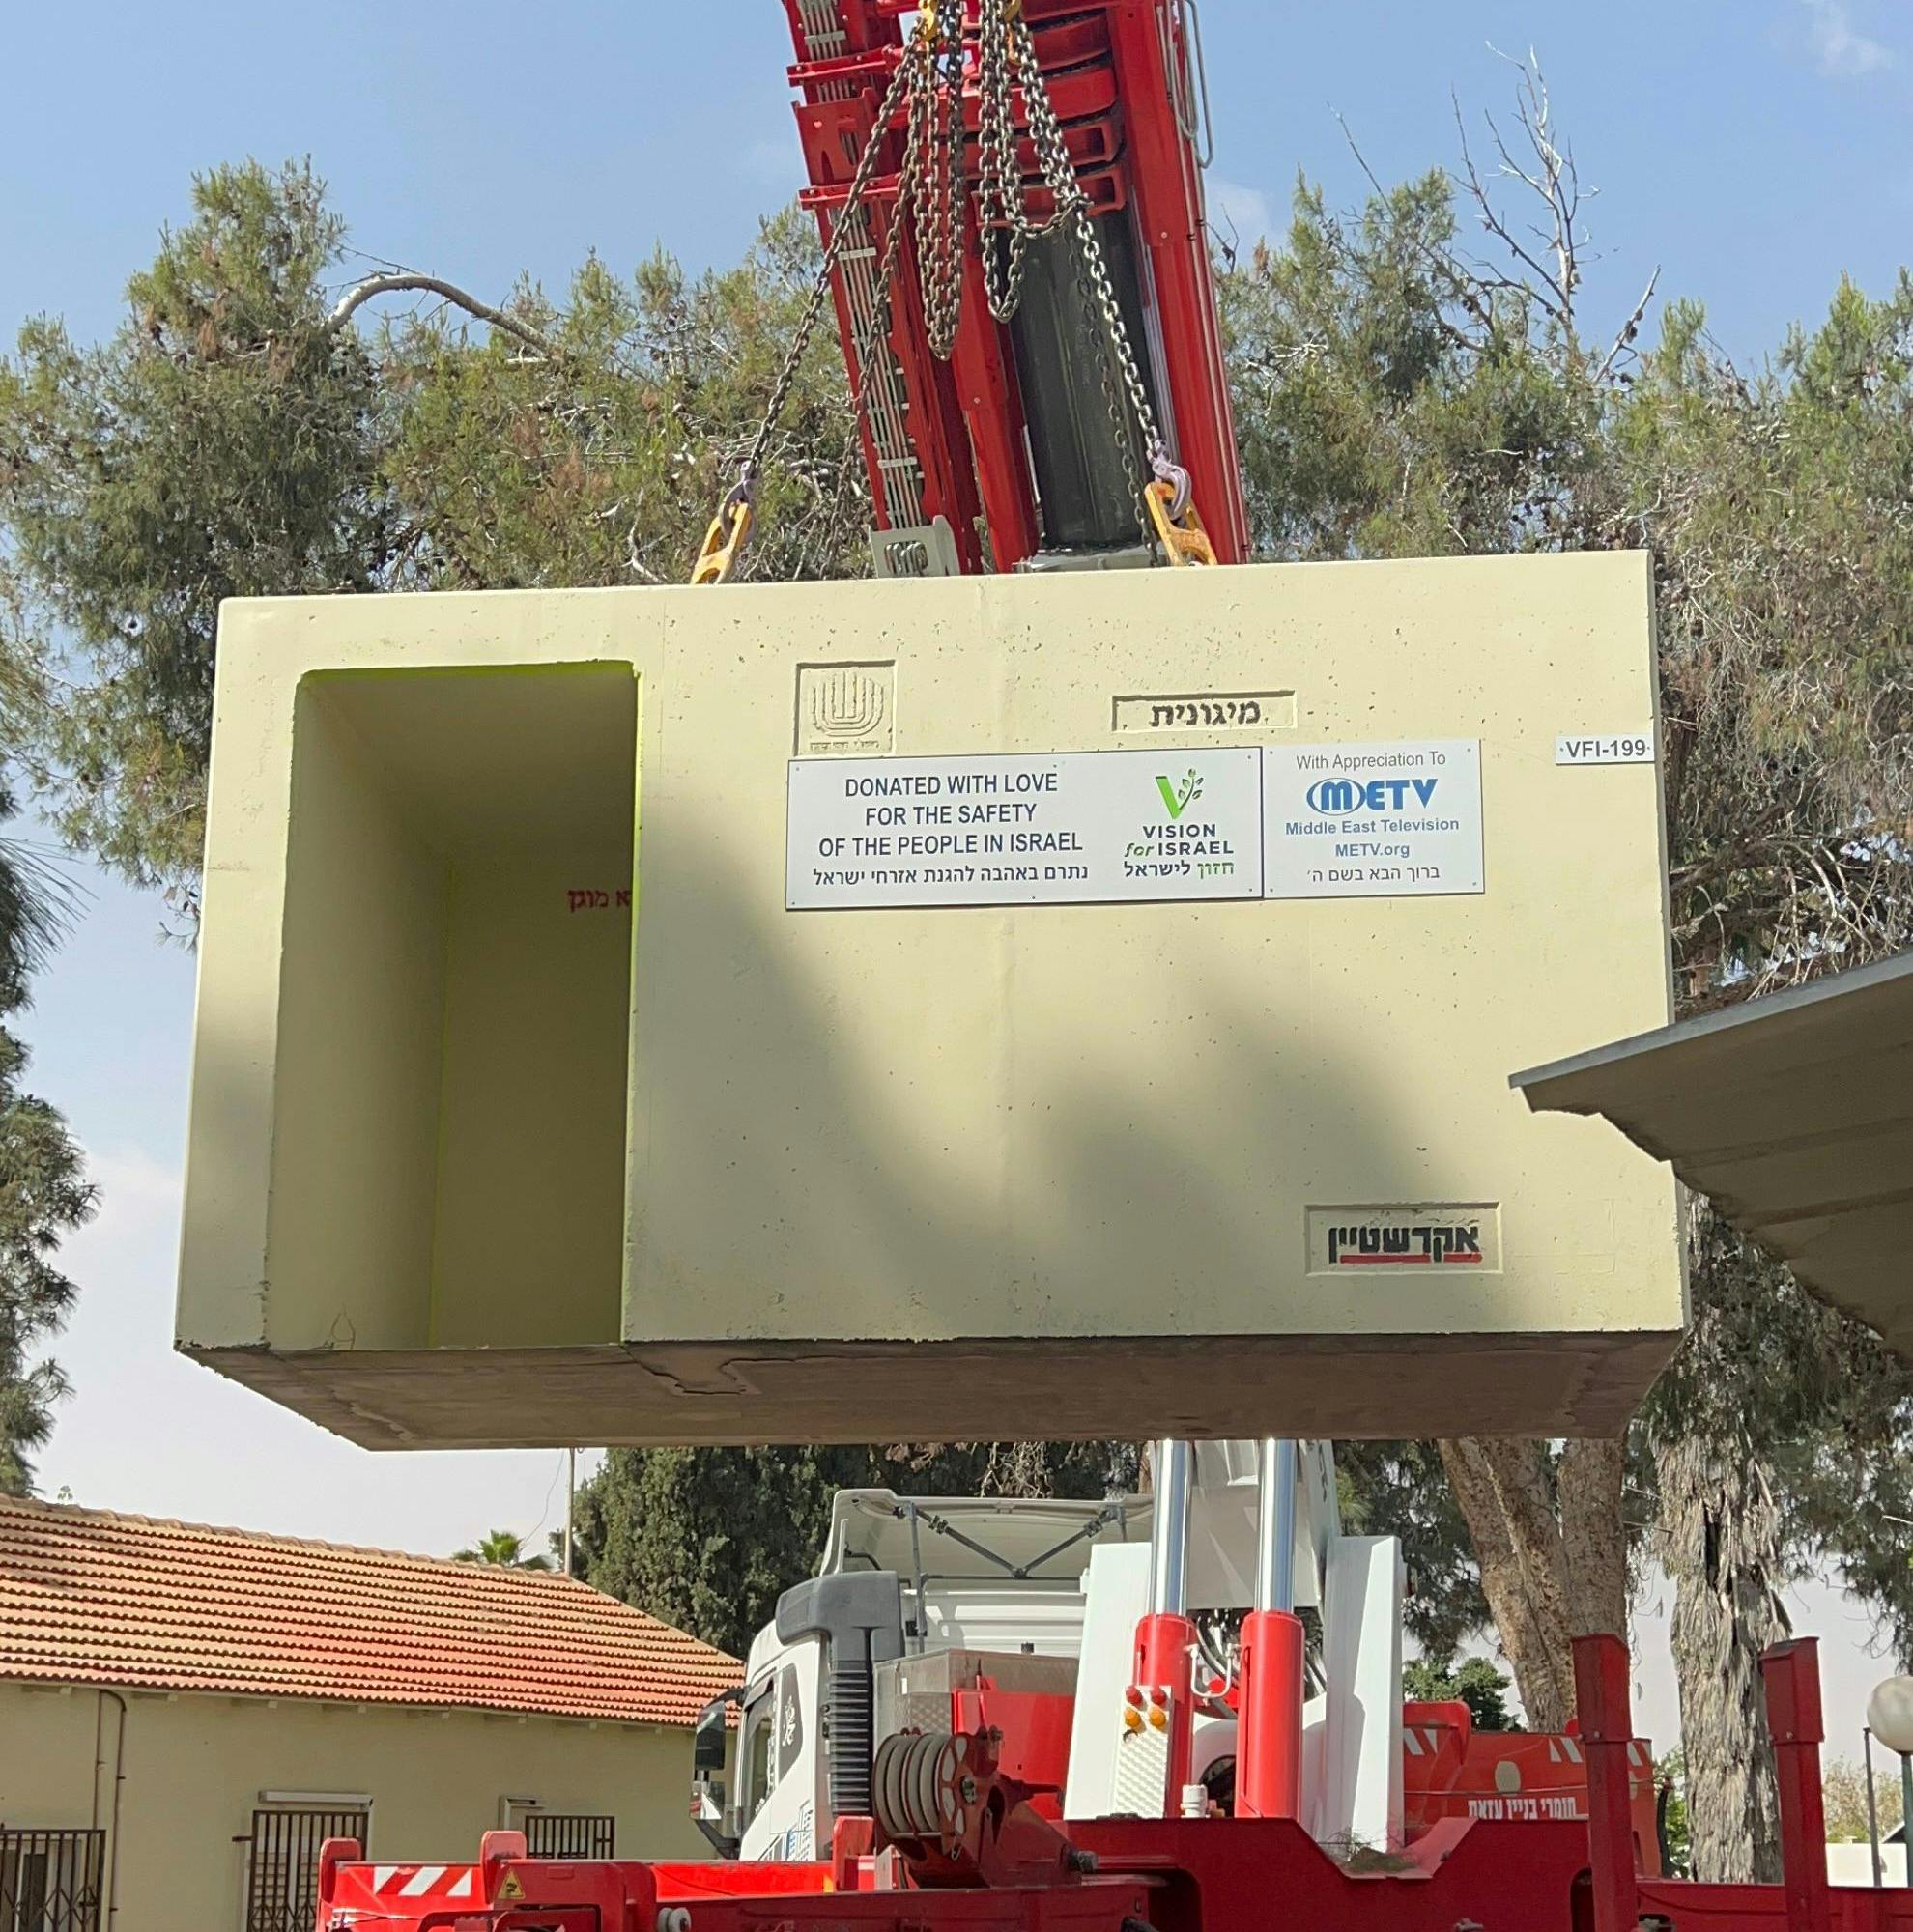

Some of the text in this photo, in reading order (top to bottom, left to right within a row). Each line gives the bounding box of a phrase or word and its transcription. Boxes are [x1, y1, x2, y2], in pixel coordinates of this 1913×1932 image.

[1150, 701, 1261, 727] מיגונית
[1566, 739, 1646, 758] VFI-199
[1297, 751, 1446, 772] With Appreciation To
[845, 773, 1058, 797] DONATED WITH LOVE
[1318, 778, 1439, 811] METV
[866, 804, 1037, 826] FOR THE SAFETY
[1142, 824, 1216, 838] VISION
[1285, 817, 1460, 836] Middle East Television
[819, 832, 1083, 858] OF THE PEOPLE IN ISRAEL
[1124, 840, 1235, 858] for ISRAEL
[1335, 843, 1410, 858] METV.org
[814, 865, 1089, 886] נתרם באהבה להגנת אזרחי ישראל
[1124, 859, 1234, 879] חזון לישראל
[1328, 868, 1364, 882] בשם
[1369, 867, 1401, 881] הבא
[1407, 867, 1440, 882] ברוך
[1328, 1226, 1478, 1264] אקרשטיין
[1506, 1799, 1539, 1820] בניין
[1540, 1797, 1577, 1819] חומרי
